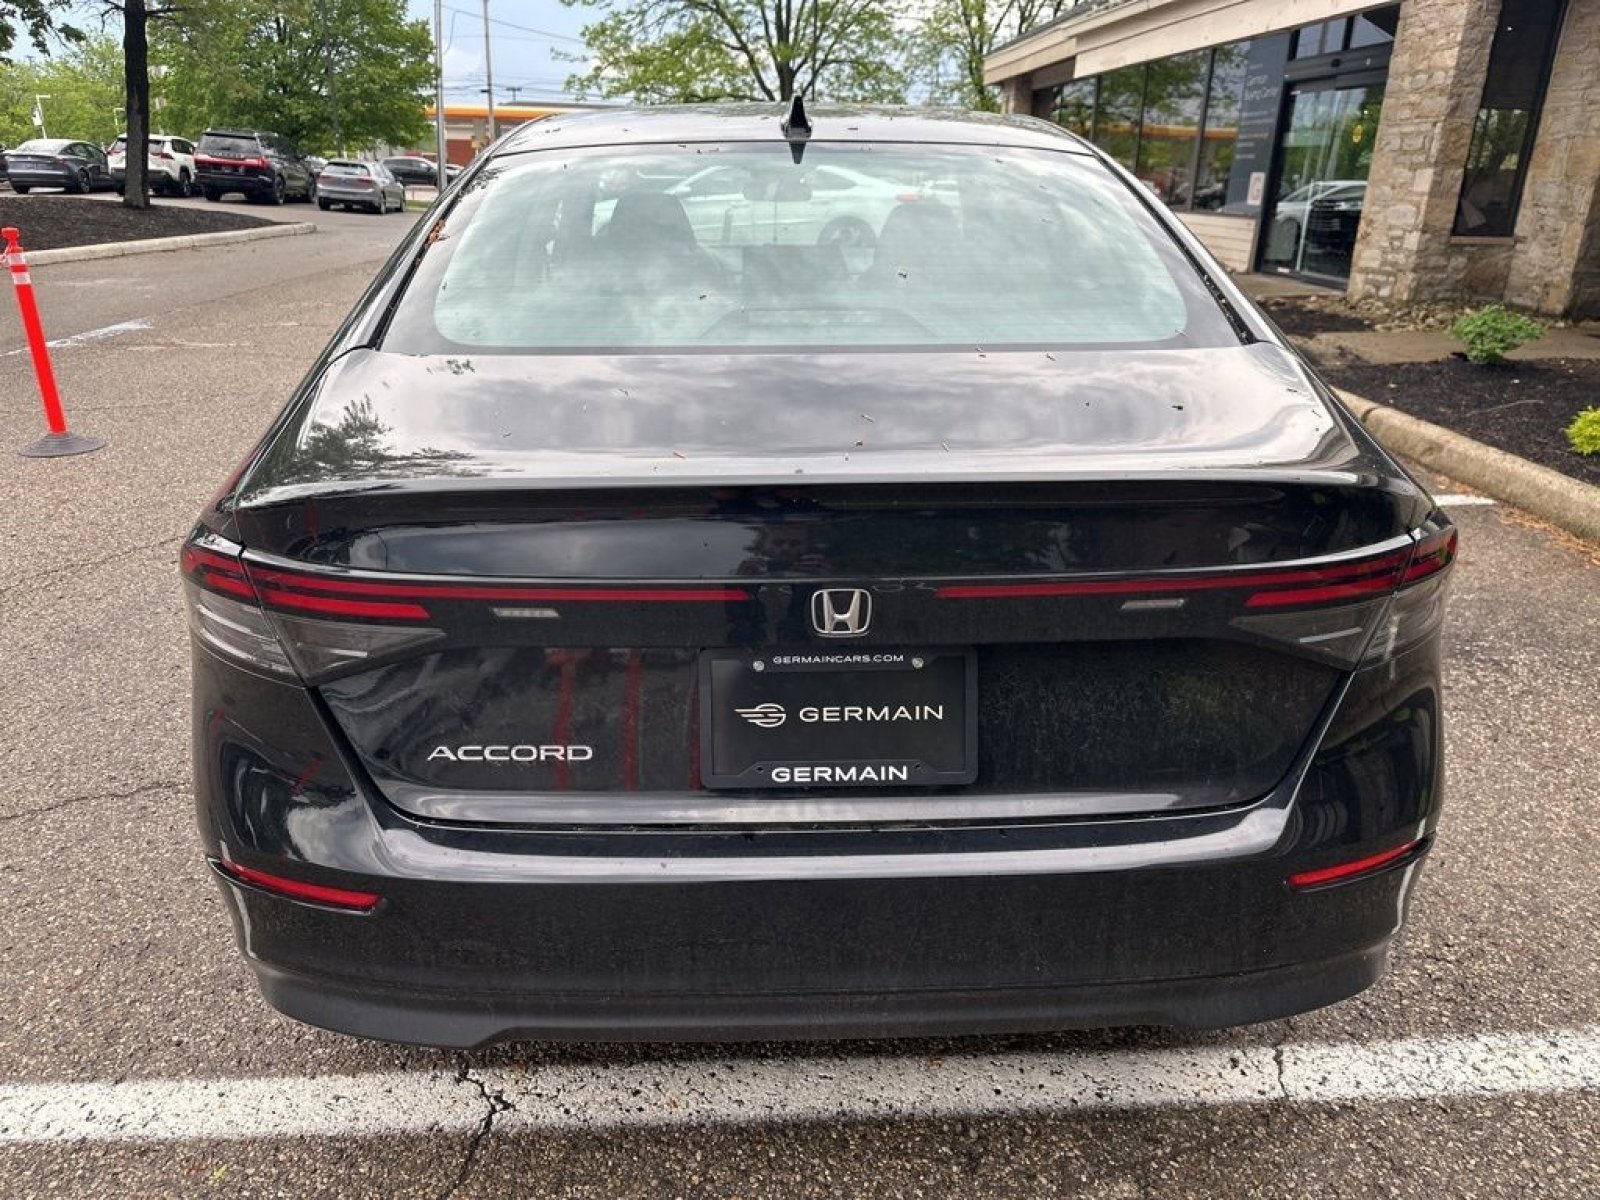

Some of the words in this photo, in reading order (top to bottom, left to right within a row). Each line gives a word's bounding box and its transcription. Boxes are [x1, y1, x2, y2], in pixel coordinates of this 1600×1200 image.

[772, 654, 904, 665] GERMAINCARS.COM
[799, 704, 943, 723] GERMAIN
[426, 744, 593, 762] ACCORD
[771, 765, 908, 783] GERMAIN
